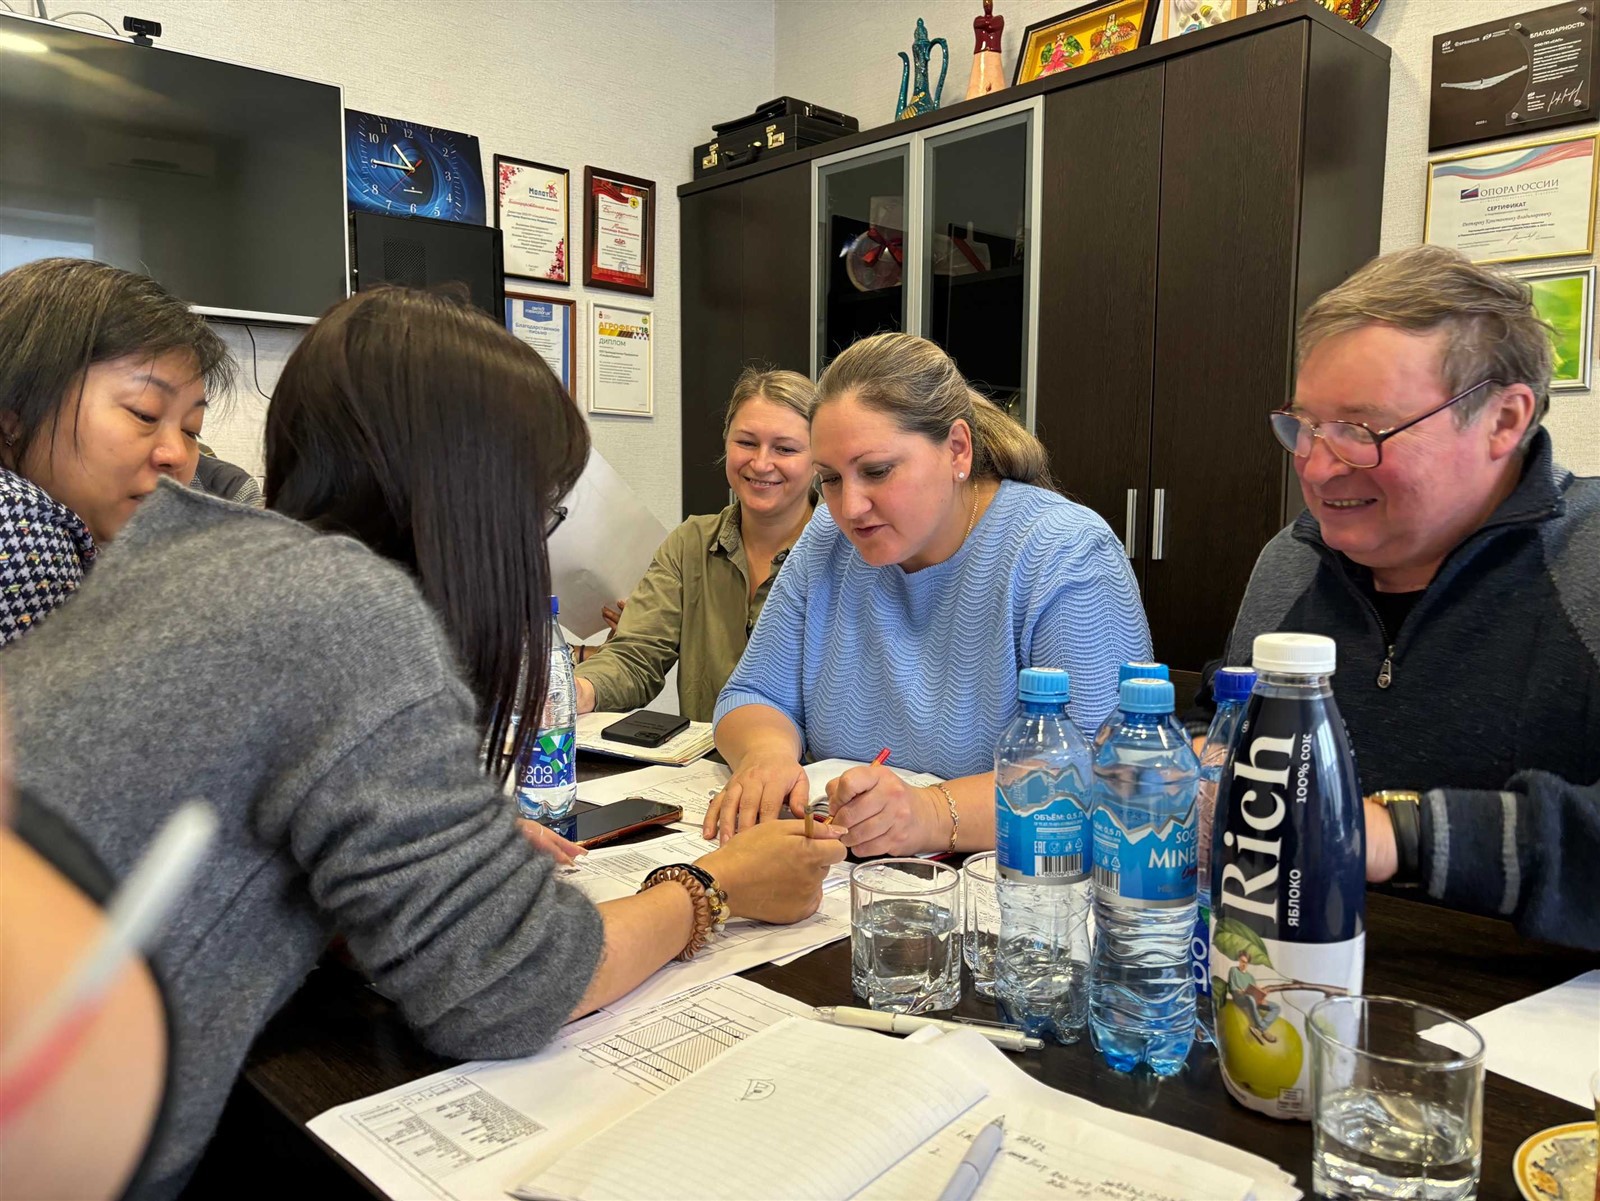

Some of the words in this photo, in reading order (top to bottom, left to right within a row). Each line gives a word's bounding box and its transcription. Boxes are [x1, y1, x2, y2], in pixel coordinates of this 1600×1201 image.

[1529, 21, 1585, 39] БЛАГОДАРНОСТЬ
[379, 123, 388, 134] 11
[403, 128, 414, 139] 12
[368, 132, 379, 144] 10
[429, 133, 434, 143] 1
[442, 147, 449, 157] 2
[444, 171, 452, 181] 3
[371, 184, 379, 195] 8
[1480, 185, 1515, 197] ОПОРА
[1516, 179, 1559, 192] РОССИИ
[445, 193, 452, 203] 4
[385, 199, 392, 210] 7
[410, 203, 417, 214] 6
[1486, 201, 1527, 212] СЕРТИФИКАТ
[434, 206, 440, 217] 5
[598, 337, 626, 347] ДИПЛОМ
[1296, 762, 1310, 804] 100%
[1221, 733, 1297, 925] Rich
[1287, 869, 1301, 928] ЯБЛОКО
